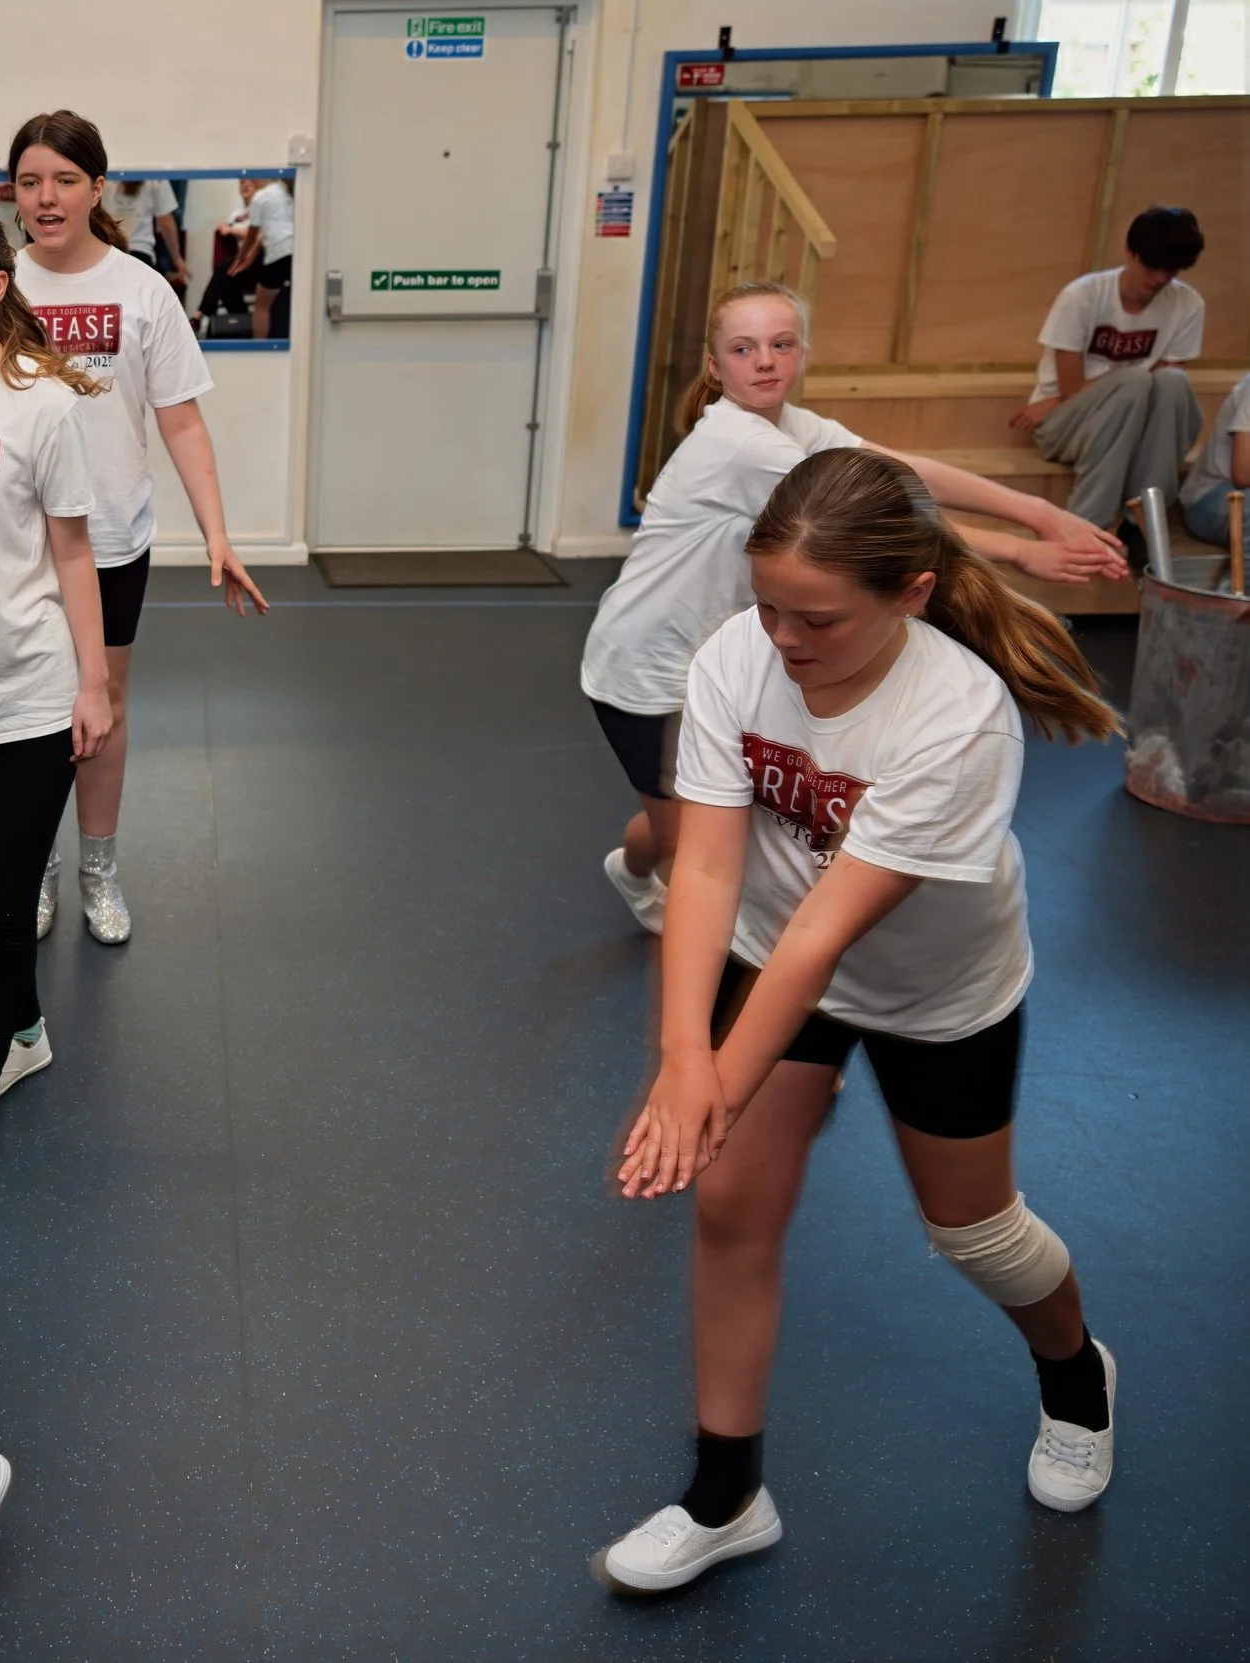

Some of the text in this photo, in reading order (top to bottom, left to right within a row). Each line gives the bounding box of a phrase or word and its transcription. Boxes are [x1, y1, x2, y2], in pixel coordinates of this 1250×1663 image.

[430, 20, 482, 34] Fire exit
[428, 43, 481, 56] Keep clear
[393, 275, 498, 288] Push bar to open
[38, 314, 114, 342] EASE
[58, 342, 95, 352] USICAL
[762, 747, 781, 762] WE
[786, 754, 803, 767] GO
